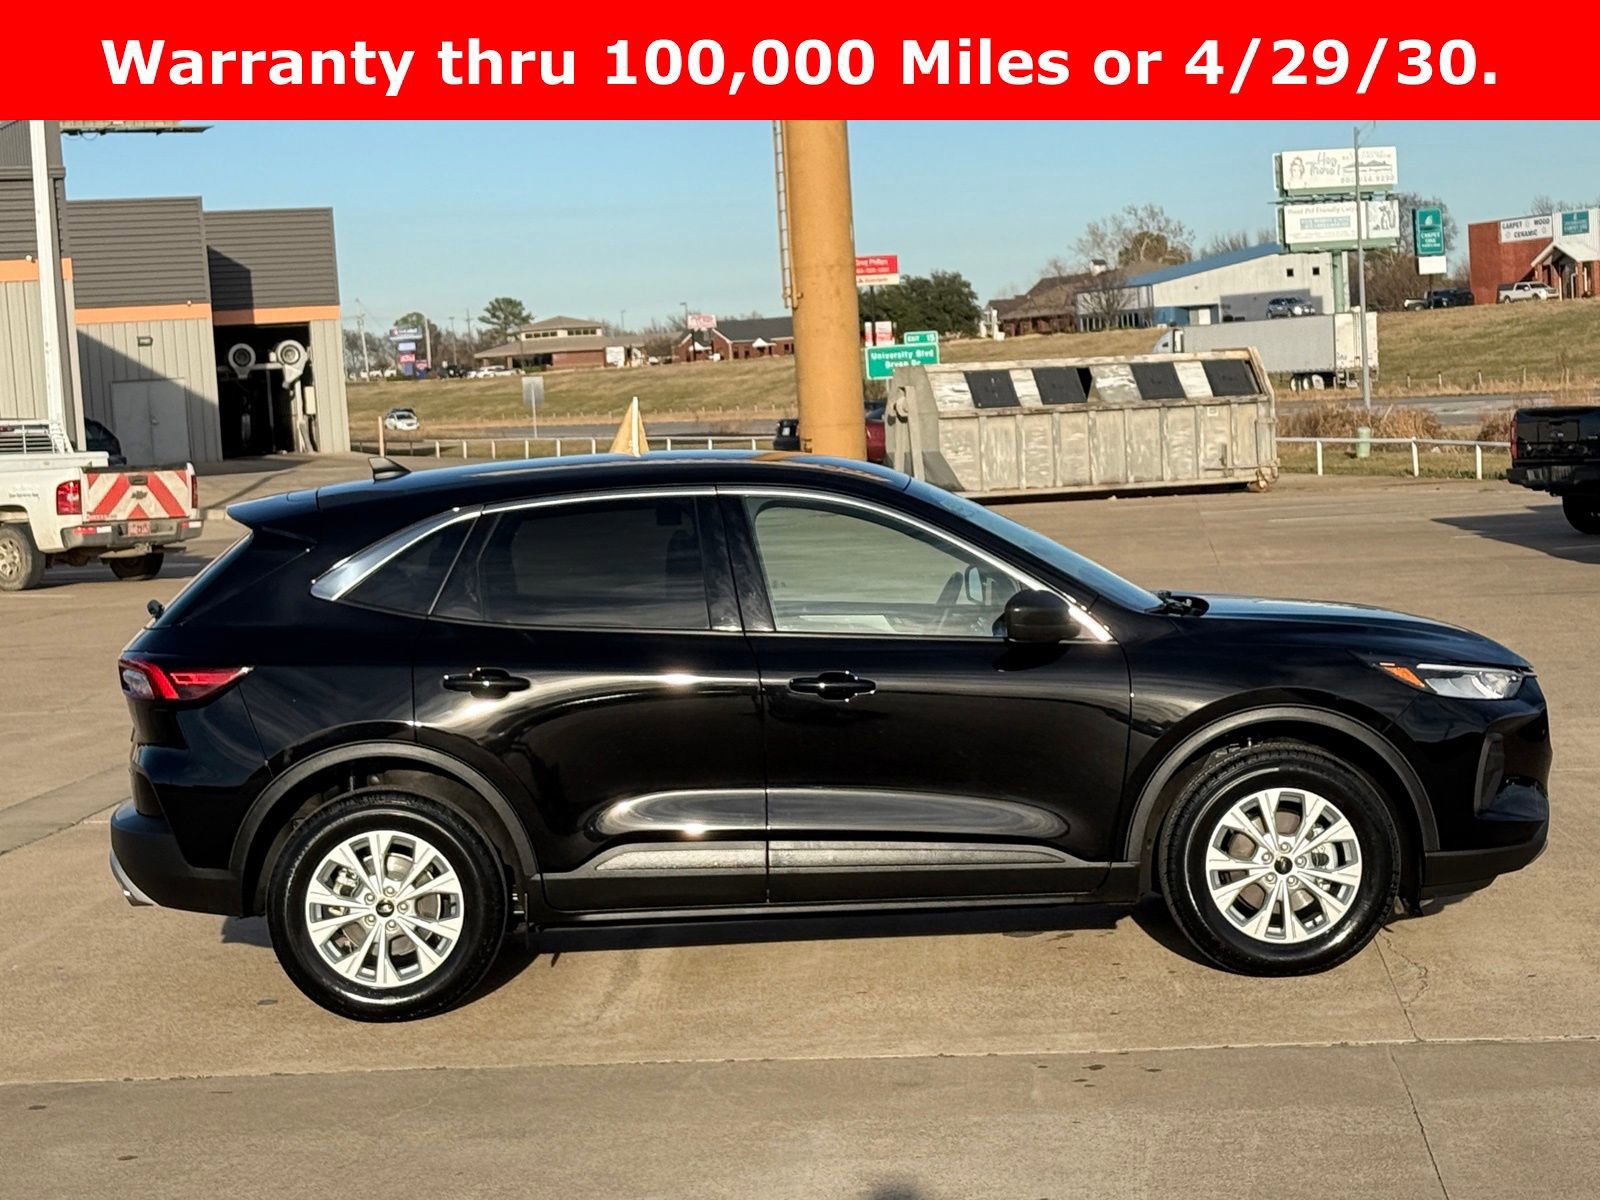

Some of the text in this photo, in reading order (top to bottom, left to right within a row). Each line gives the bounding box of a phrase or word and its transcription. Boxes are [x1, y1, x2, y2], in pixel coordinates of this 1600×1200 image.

[1502, 218, 1550, 230] CARPET WOOD
[1513, 229, 1538, 238] CERAMIC
[870, 349, 934, 360] University Blvd
